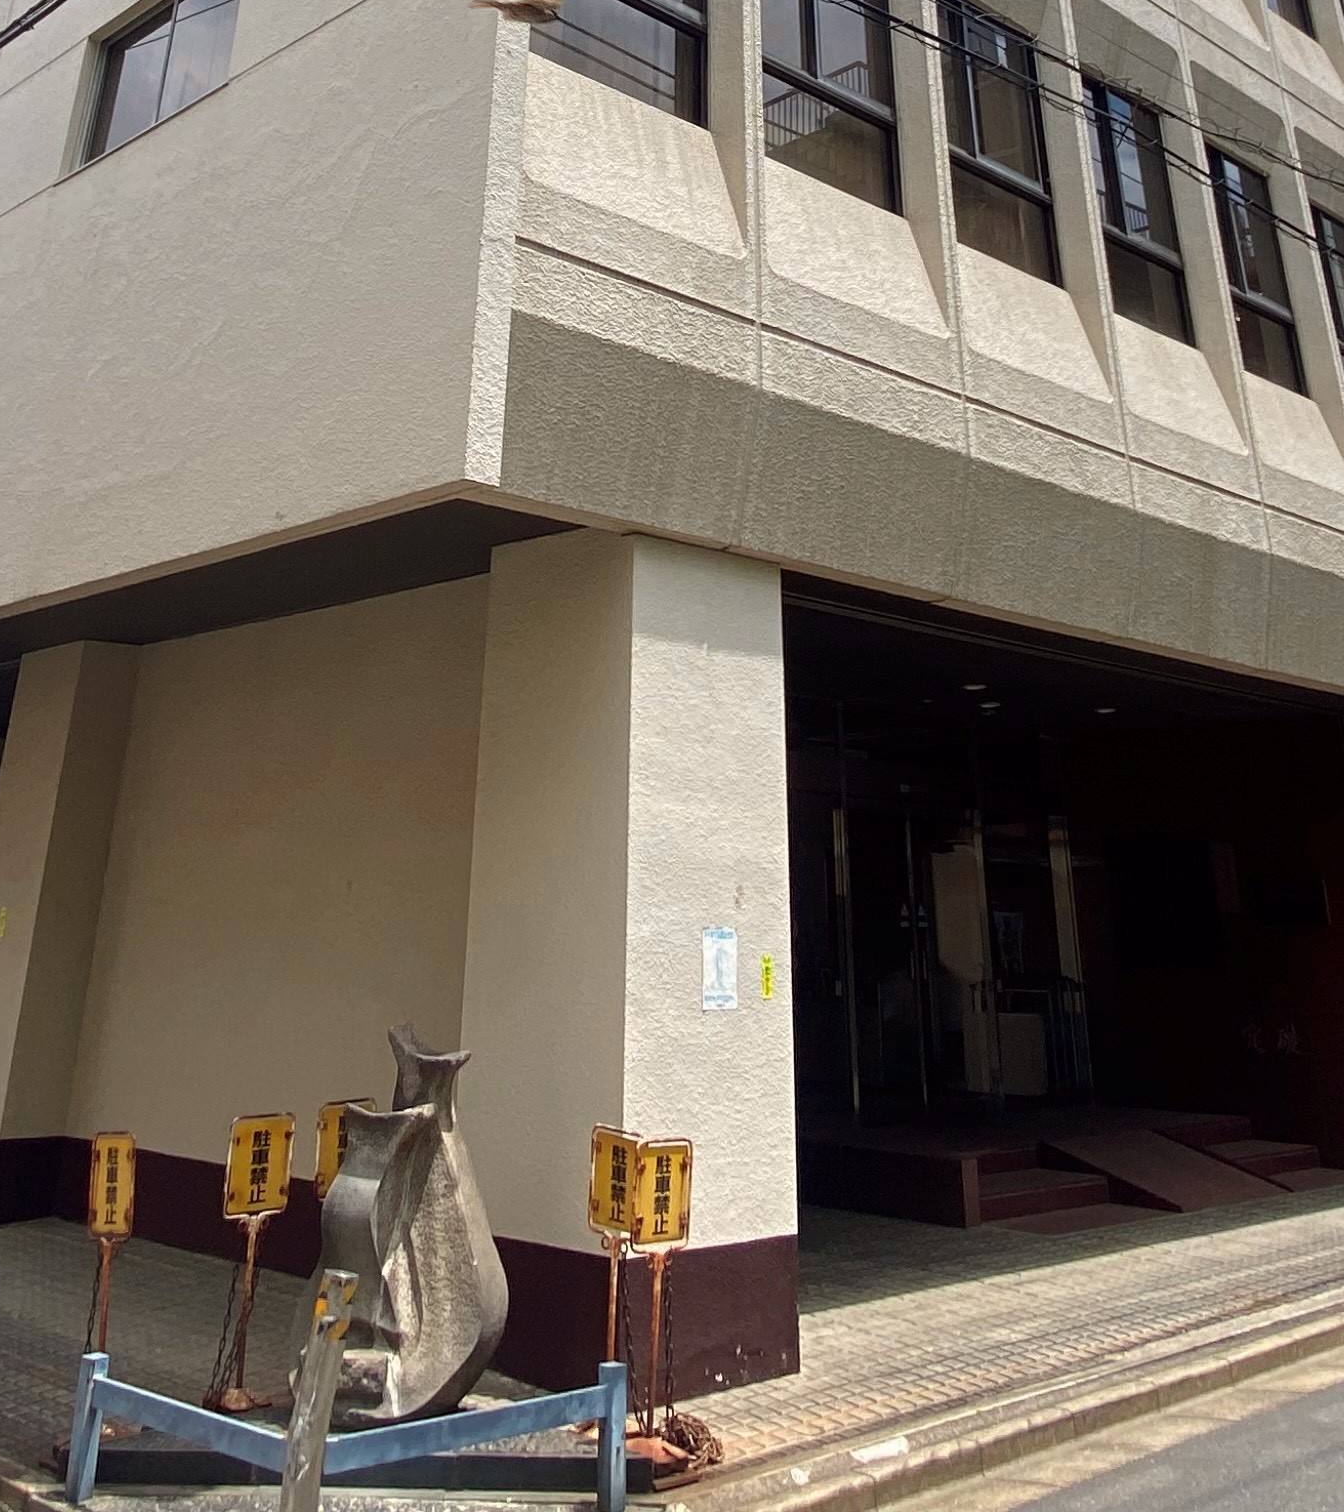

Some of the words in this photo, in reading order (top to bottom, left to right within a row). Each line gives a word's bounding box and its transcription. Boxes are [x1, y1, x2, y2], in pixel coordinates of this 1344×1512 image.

[103, 1146, 119, 1226] 駐車禁止
[247, 1129, 272, 1205] 駐車禁止
[609, 1144, 629, 1224] 駐車禁止
[652, 1154, 672, 1236] 駐車禁止
